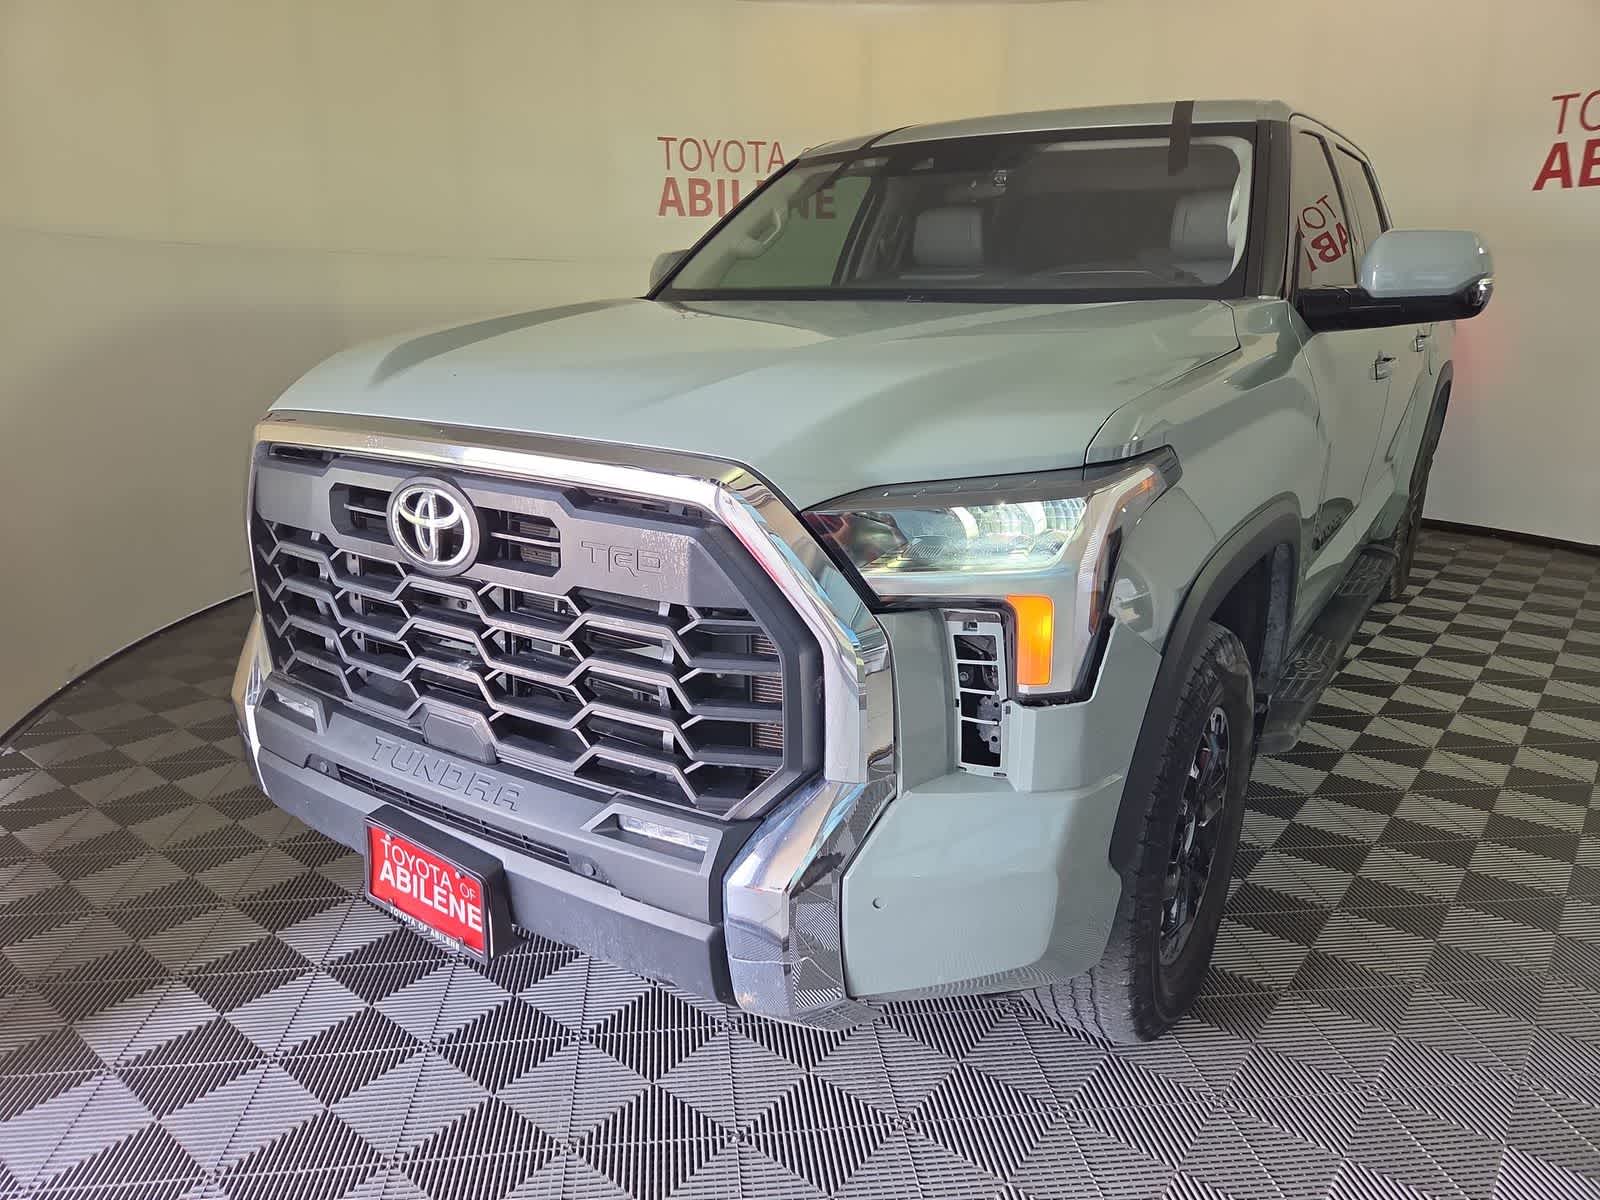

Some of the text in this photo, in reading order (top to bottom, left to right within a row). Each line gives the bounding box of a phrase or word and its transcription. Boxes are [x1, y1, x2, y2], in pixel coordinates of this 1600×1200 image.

[657, 135, 785, 174] TOYOTA
[580, 540, 664, 578] TRD
[370, 736, 527, 812] TUNDRA
[379, 837, 477, 900] TOYOTA OF
[379, 863, 483, 931] ABILENE
[389, 905, 416, 928] TOYOTA
